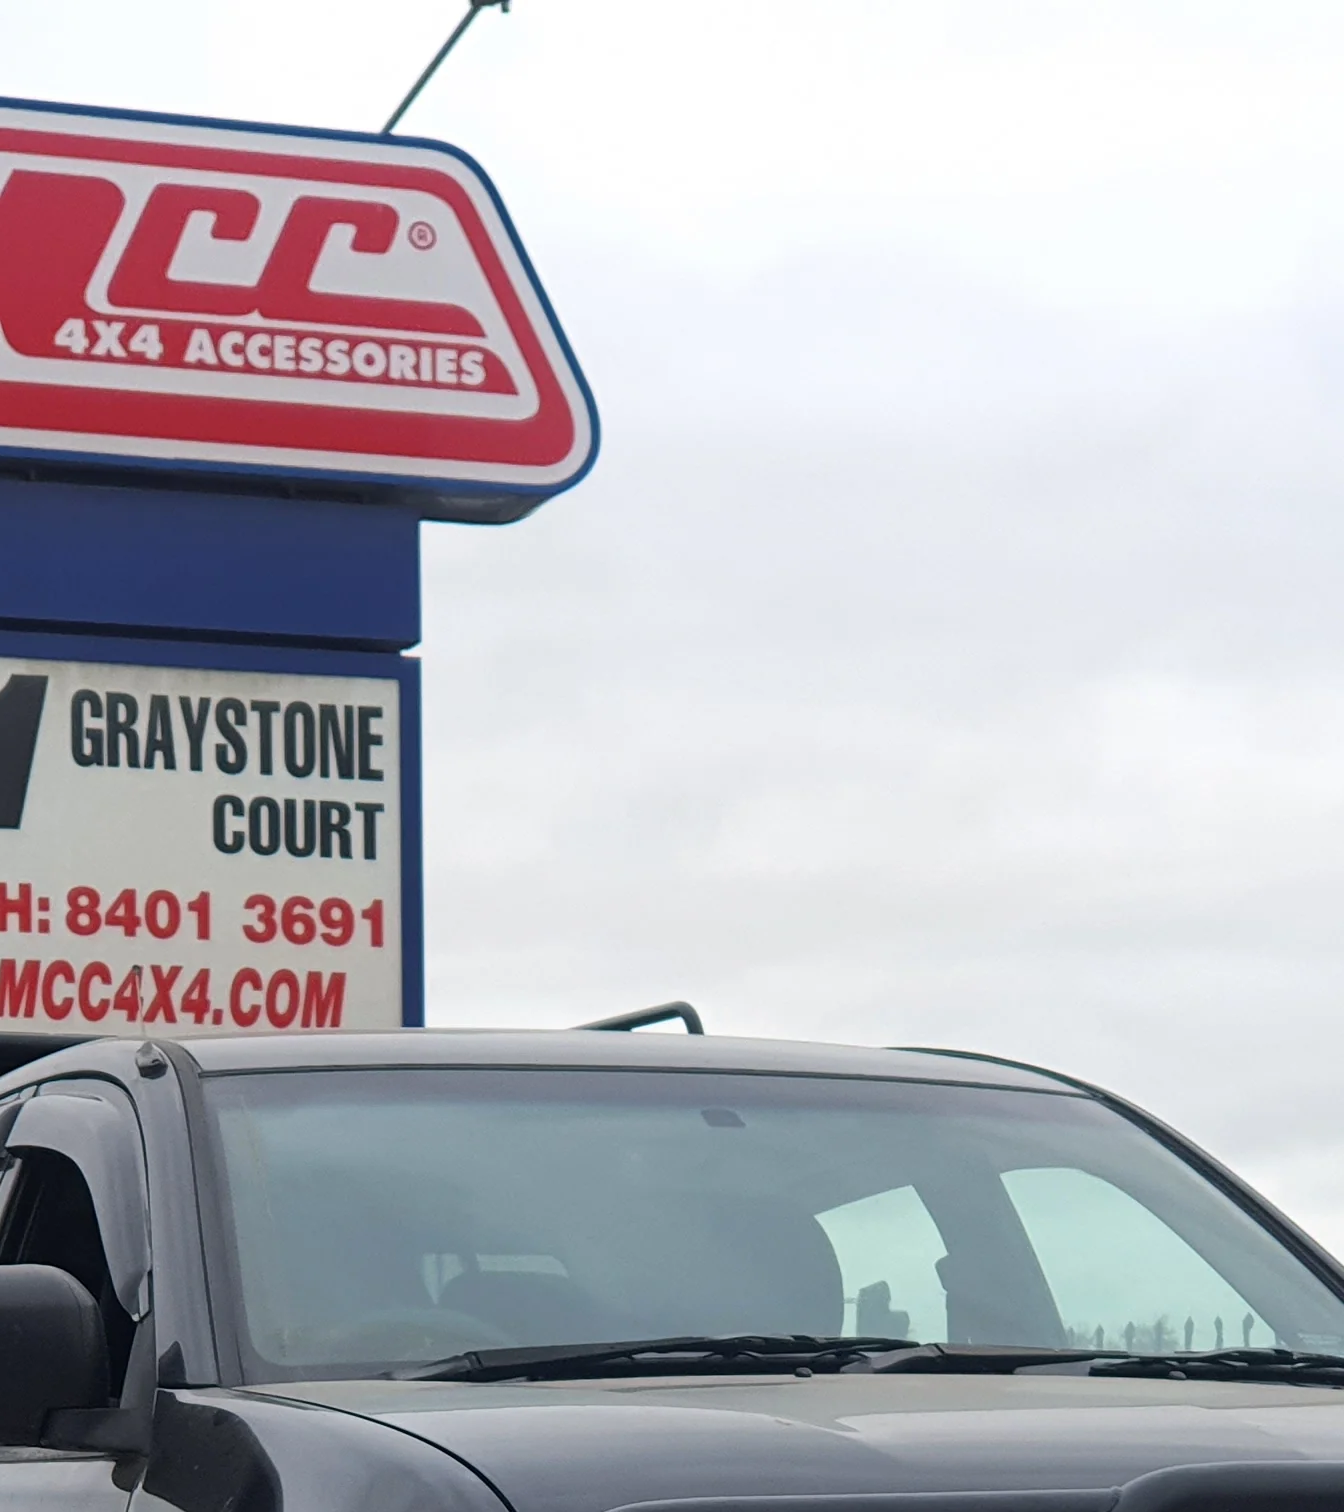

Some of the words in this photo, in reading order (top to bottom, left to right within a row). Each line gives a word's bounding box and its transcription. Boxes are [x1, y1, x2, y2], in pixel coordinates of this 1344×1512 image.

[55, 318, 164, 361] 4X4
[183, 327, 487, 386] ACCESSORIES
[71, 689, 384, 781] GRAYSTONE
[213, 795, 385, 860] COURT
[65, 886, 211, 941] 8401
[243, 895, 385, 948] 3691
